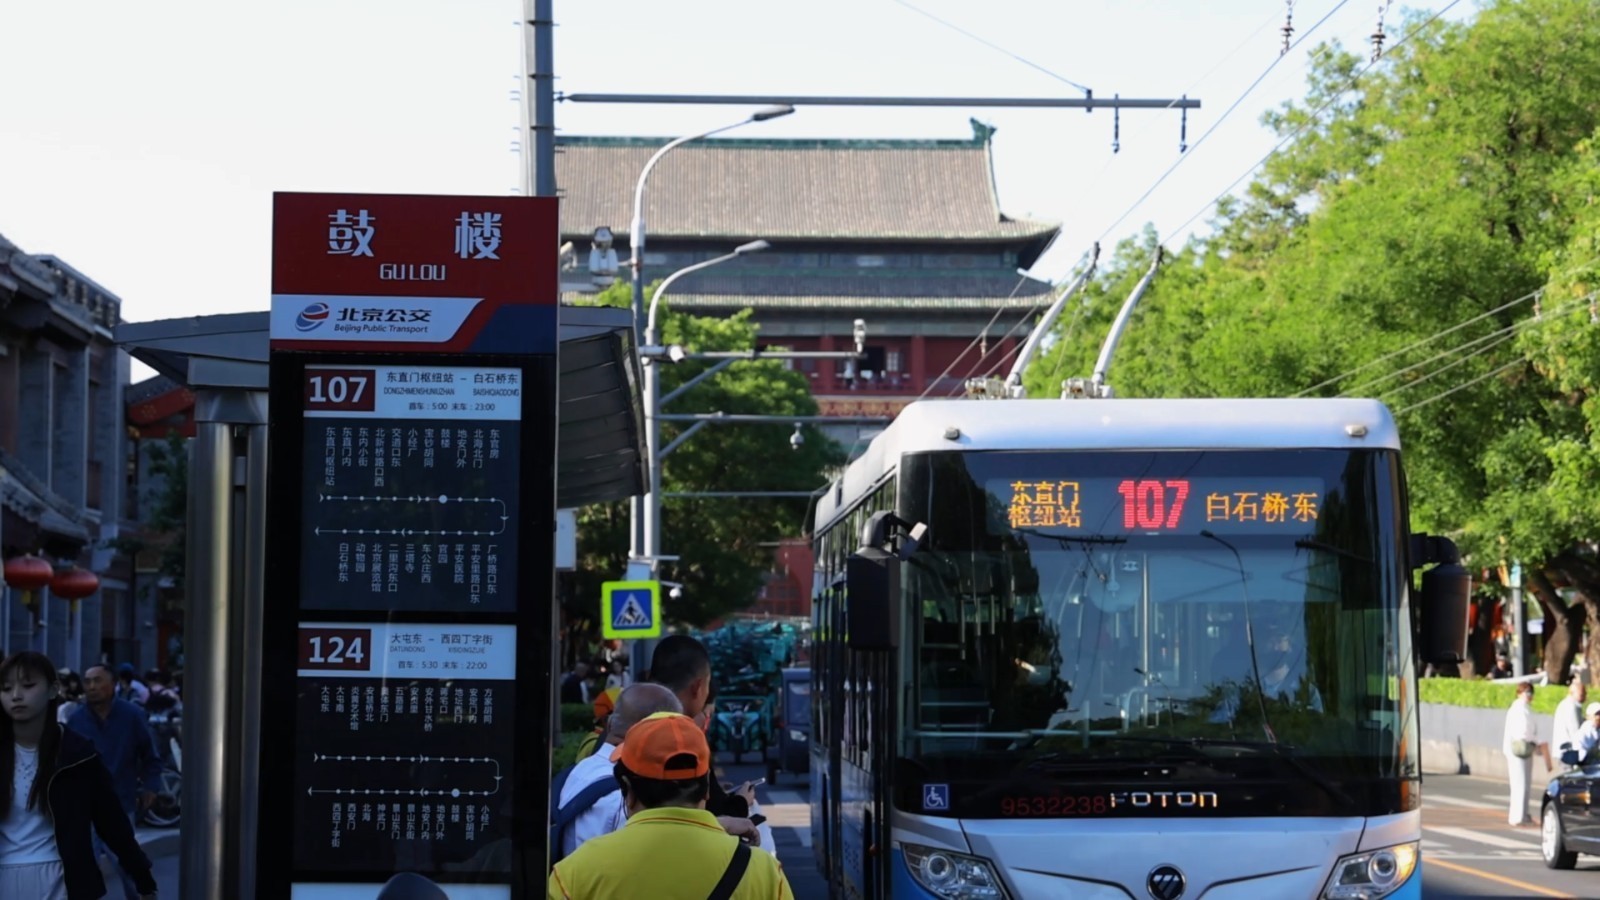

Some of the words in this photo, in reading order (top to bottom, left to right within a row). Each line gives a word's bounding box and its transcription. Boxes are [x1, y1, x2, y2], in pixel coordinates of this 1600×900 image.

[327, 209, 502, 259] 鼓楼
[380, 263, 406, 280] GU
[409, 264, 446, 281] LOU
[334, 324, 361, 333] Beijing
[363, 324, 387, 333] Public
[388, 325, 428, 334] Transport
[336, 307, 432, 323] 北京公交
[310, 376, 367, 403] 107
[386, 372, 454, 383] 东直门枢纽站
[474, 373, 518, 384] 白石桥东
[342, 427, 352, 467] 东直门内
[358, 428, 368, 467] 东内小街
[391, 428, 401, 467] 交道口东
[408, 428, 418, 457] 小经厂
[424, 428, 434, 468] 宝钞胡同
[440, 428, 450, 448] 鼓楼
[456, 429, 467, 468] 地安门外
[473, 429, 483, 469] 北海北门
[489, 429, 500, 459] 东官房
[325, 427, 336, 486] 东直门枢纽站
[374, 428, 385, 487] 北新桥路口西
[1009, 480, 1080, 505] 东直门
[1118, 480, 1190, 529] 107
[1206, 492, 1318, 522] 白石桥东
[1007, 504, 1081, 528] 枢纽站
[339, 543, 349, 582] 白石桥东
[355, 543, 365, 573] 动物园
[371, 543, 382, 592] 北京展览馆
[388, 543, 399, 592] 二里沟东口
[405, 543, 415, 573] 三塔寺
[421, 544, 432, 584] 车公庄西
[438, 544, 448, 564] 官园
[454, 544, 464, 584] 平安医院
[487, 544, 497, 594] 厂桥路口东
[470, 544, 481, 604] 平安里路口东
[309, 636, 364, 663] 124
[391, 633, 422, 644] 大屯东
[441, 634, 493, 645] 西四丁字街
[320, 685, 330, 713] 大屯东
[335, 685, 345, 713] 大屯南
[1001, 795, 1107, 816] 9532238
[1110, 791, 1218, 808] FOTON
